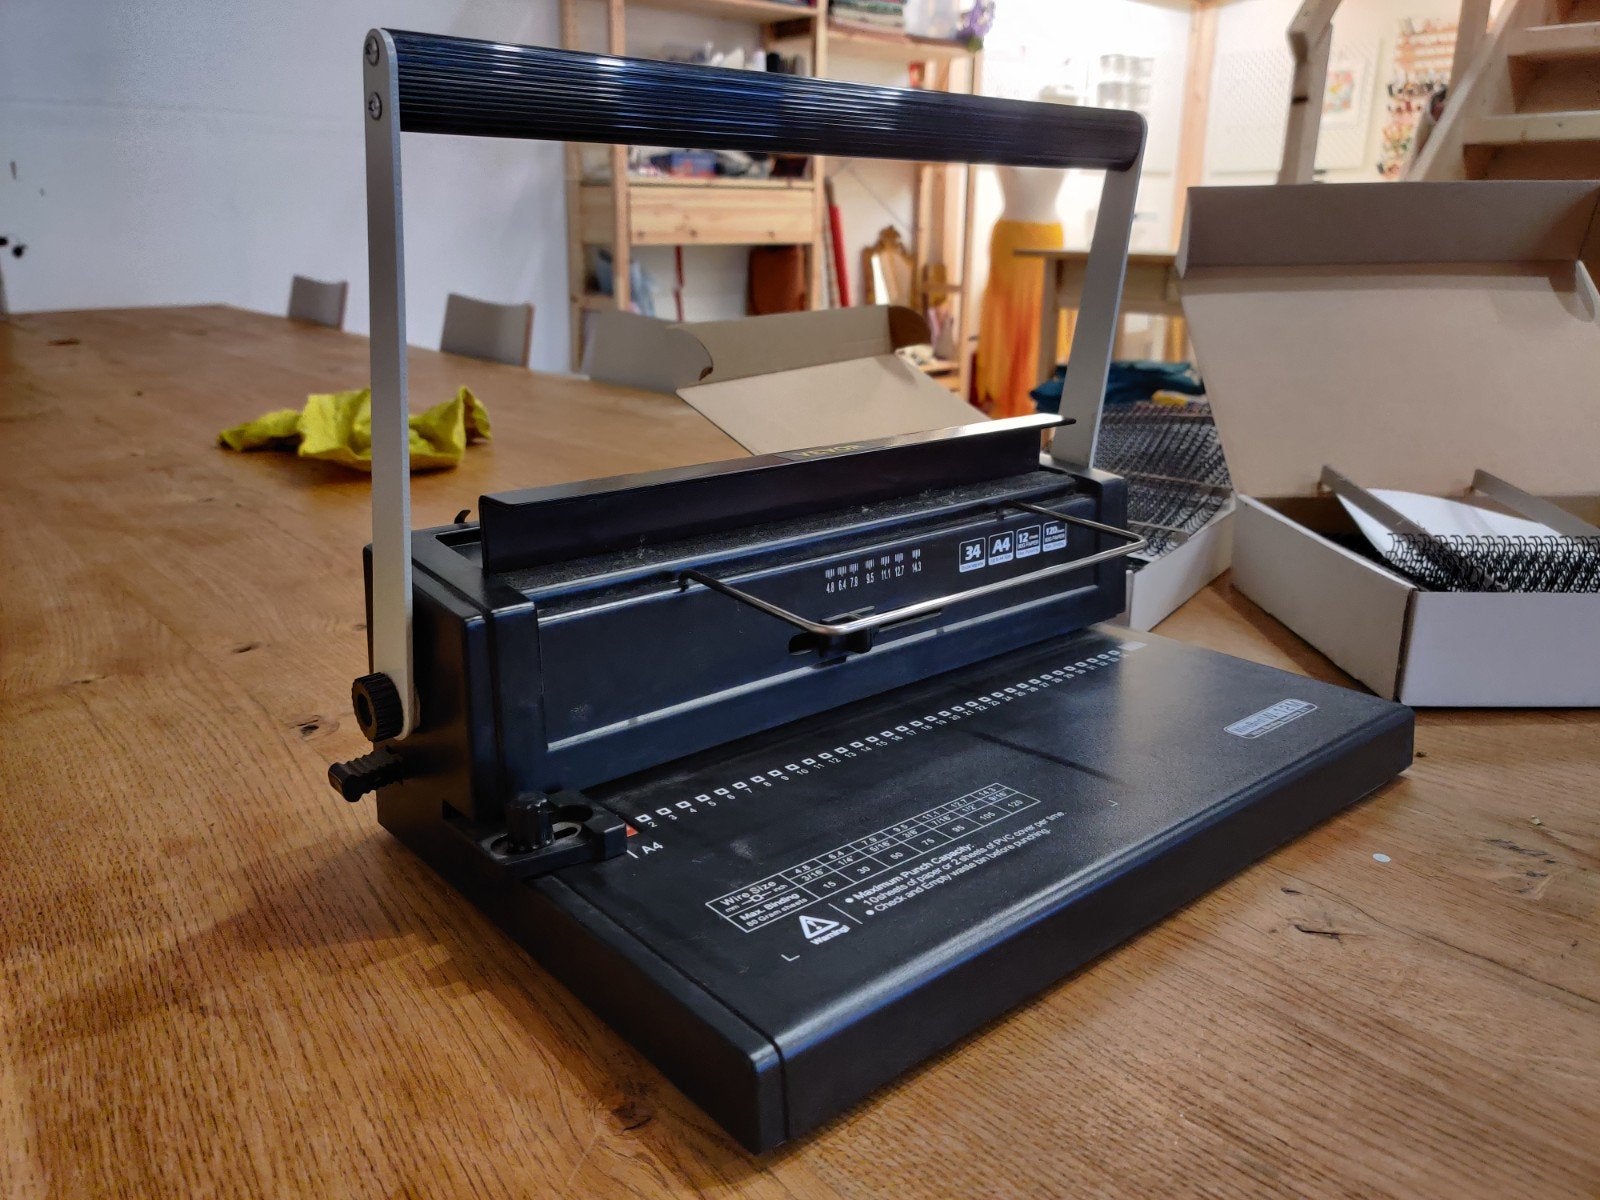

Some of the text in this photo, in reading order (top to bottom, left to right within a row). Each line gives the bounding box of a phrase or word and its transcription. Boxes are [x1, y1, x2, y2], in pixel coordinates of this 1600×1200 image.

[991, 537, 1011, 554] A4
[1018, 532, 1028, 543] 12
[965, 544, 981, 560] 34
[826, 582, 835, 593] 4.8
[838, 579, 847, 591] 6.4
[866, 572, 875, 584] 9.5
[881, 568, 891, 580] 11.1
[895, 565, 905, 577] 12.7
[912, 561, 922, 573] 14.3
[794, 787, 996, 874] 4.8 6.4 7.9 9.5 11.1 12.7 14.3
[823, 799, 1023, 889] 15 30 50 75 95 105 120
[641, 841, 664, 854] A4
[907, 878, 918, 887] of
[917, 868, 942, 882] paper
[959, 847, 987, 862] sheets
[986, 842, 995, 850] of
[993, 833, 1015, 845] PVC
[1013, 825, 1035, 837] cover
[1034, 819, 1048, 828] per
[1046, 811, 1067, 821] time.
[852, 876, 903, 900] Maximum
[900, 862, 934, 878] Punch
[874, 828, 1051, 911] Check and Empty waste bin before punching.
[720, 881, 777, 906] Wire Size
[739, 893, 800, 921] Max. Binding
[725, 904, 740, 913] mm
[745, 898, 808, 927] 80 Gram sheets
[810, 924, 850, 945] Warning!
